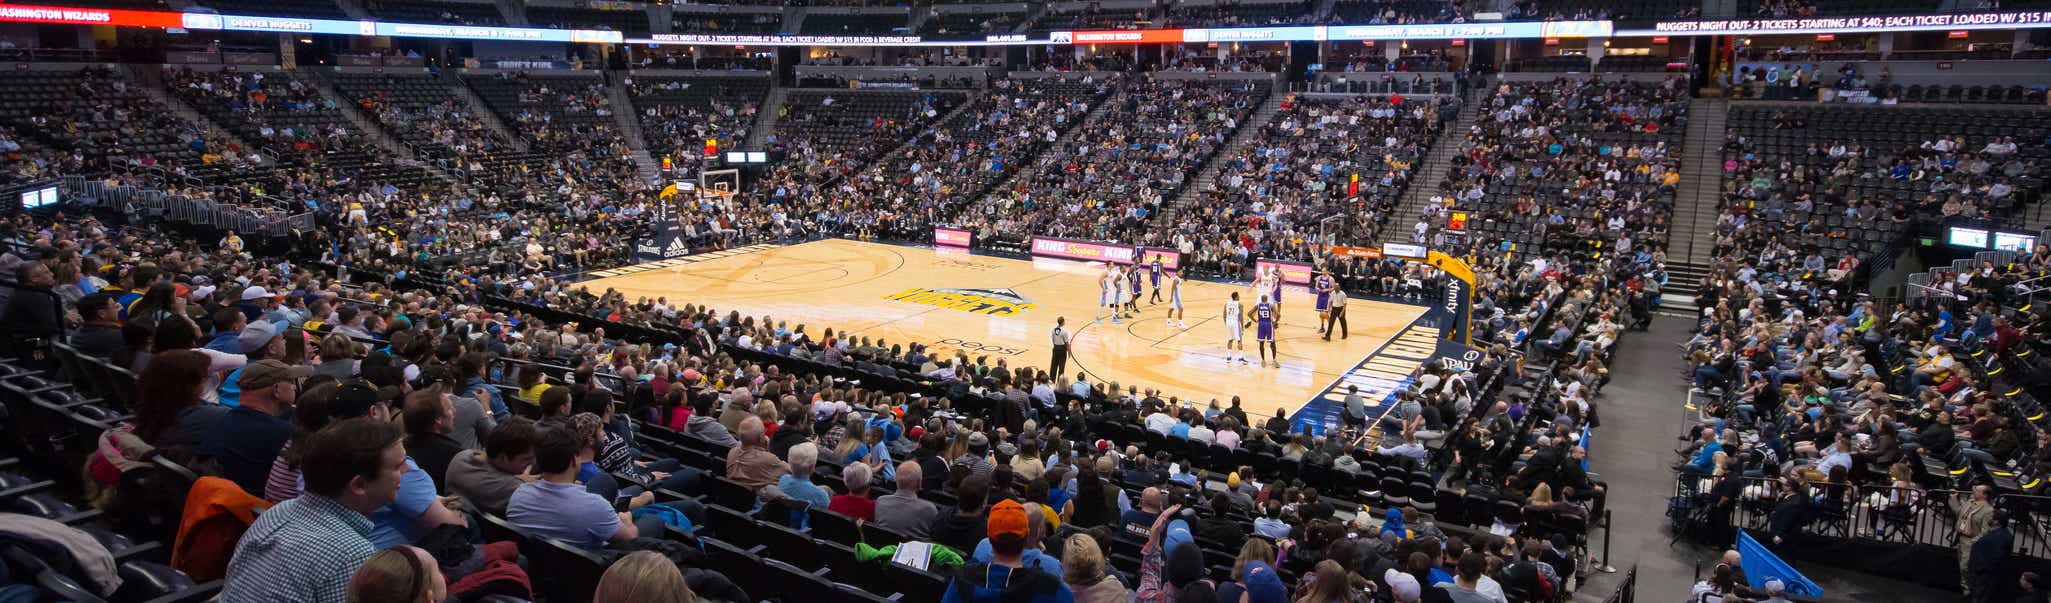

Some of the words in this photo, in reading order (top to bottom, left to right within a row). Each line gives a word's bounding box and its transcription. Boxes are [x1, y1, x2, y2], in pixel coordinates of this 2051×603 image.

[63, 11, 110, 22] WIZARDS
[1656, 21, 1698, 31] NUGGETS
[1699, 20, 1728, 30] NIGHT
[1729, 20, 1752, 30] OUT-
[1753, 20, 1759, 29] 2
[1761, 19, 1798, 29] TICKETS
[1799, 18, 1846, 28] STARTING
[1847, 17, 1859, 27] AT
[1862, 16, 1884, 28] $40;
[1886, 16, 1911, 27] EACH
[1915, 15, 1951, 26] TICKET
[1954, 14, 1999, 25] LOADED
[2001, 13, 2015, 23] W/
[2019, 12, 2041, 23] $15
[1037, 239, 1065, 252] KING
[664, 248, 689, 258] adidas
[1445, 278, 1461, 315] xfinity
